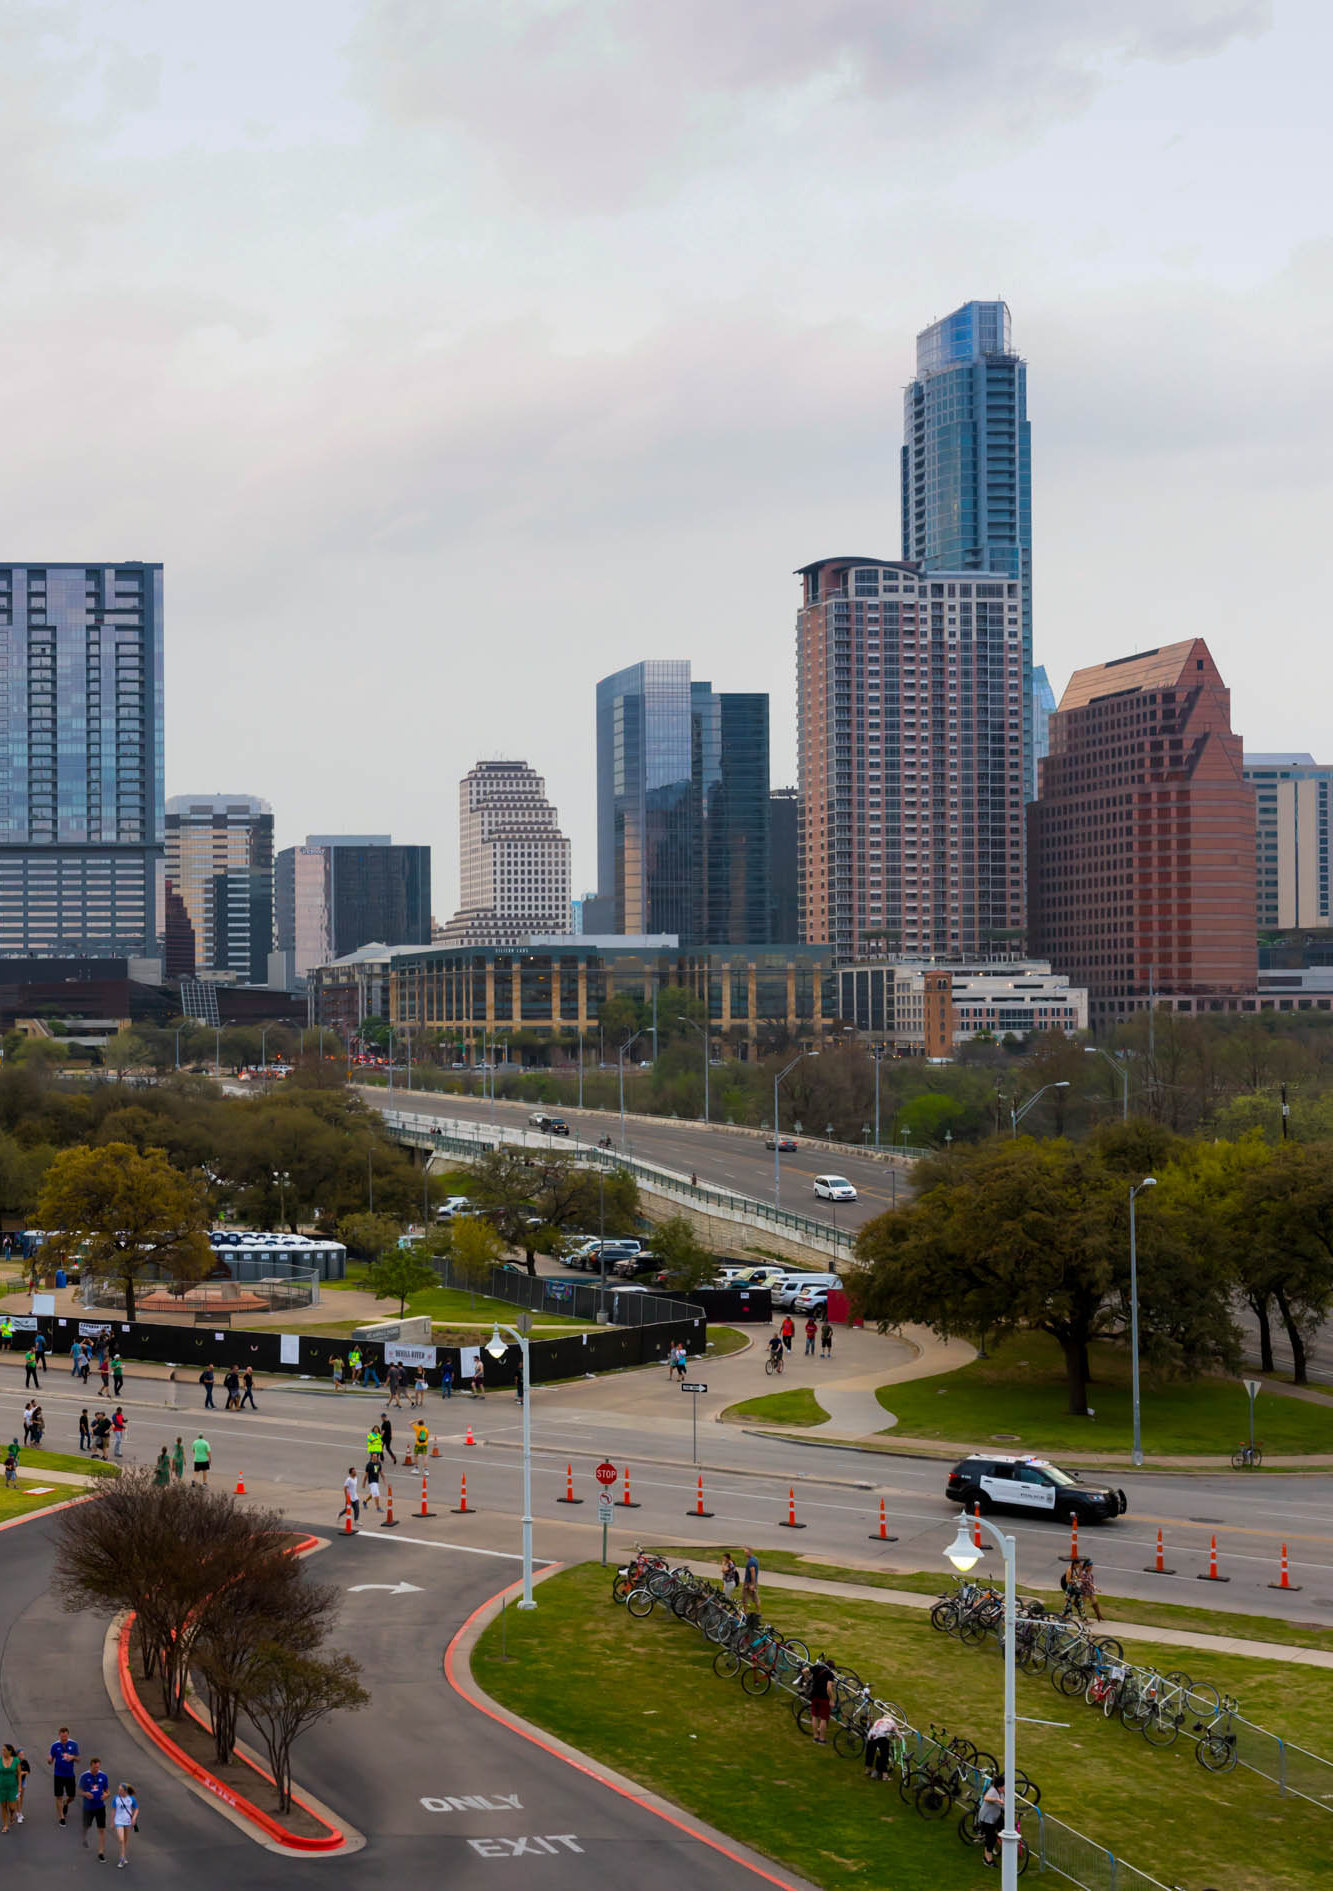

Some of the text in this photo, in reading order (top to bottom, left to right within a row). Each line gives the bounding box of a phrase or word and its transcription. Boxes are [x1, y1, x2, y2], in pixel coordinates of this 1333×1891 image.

[596, 1469, 616, 1479] STOP
[420, 1794, 525, 1812] ONLY
[466, 1834, 585, 1858] EXIT
